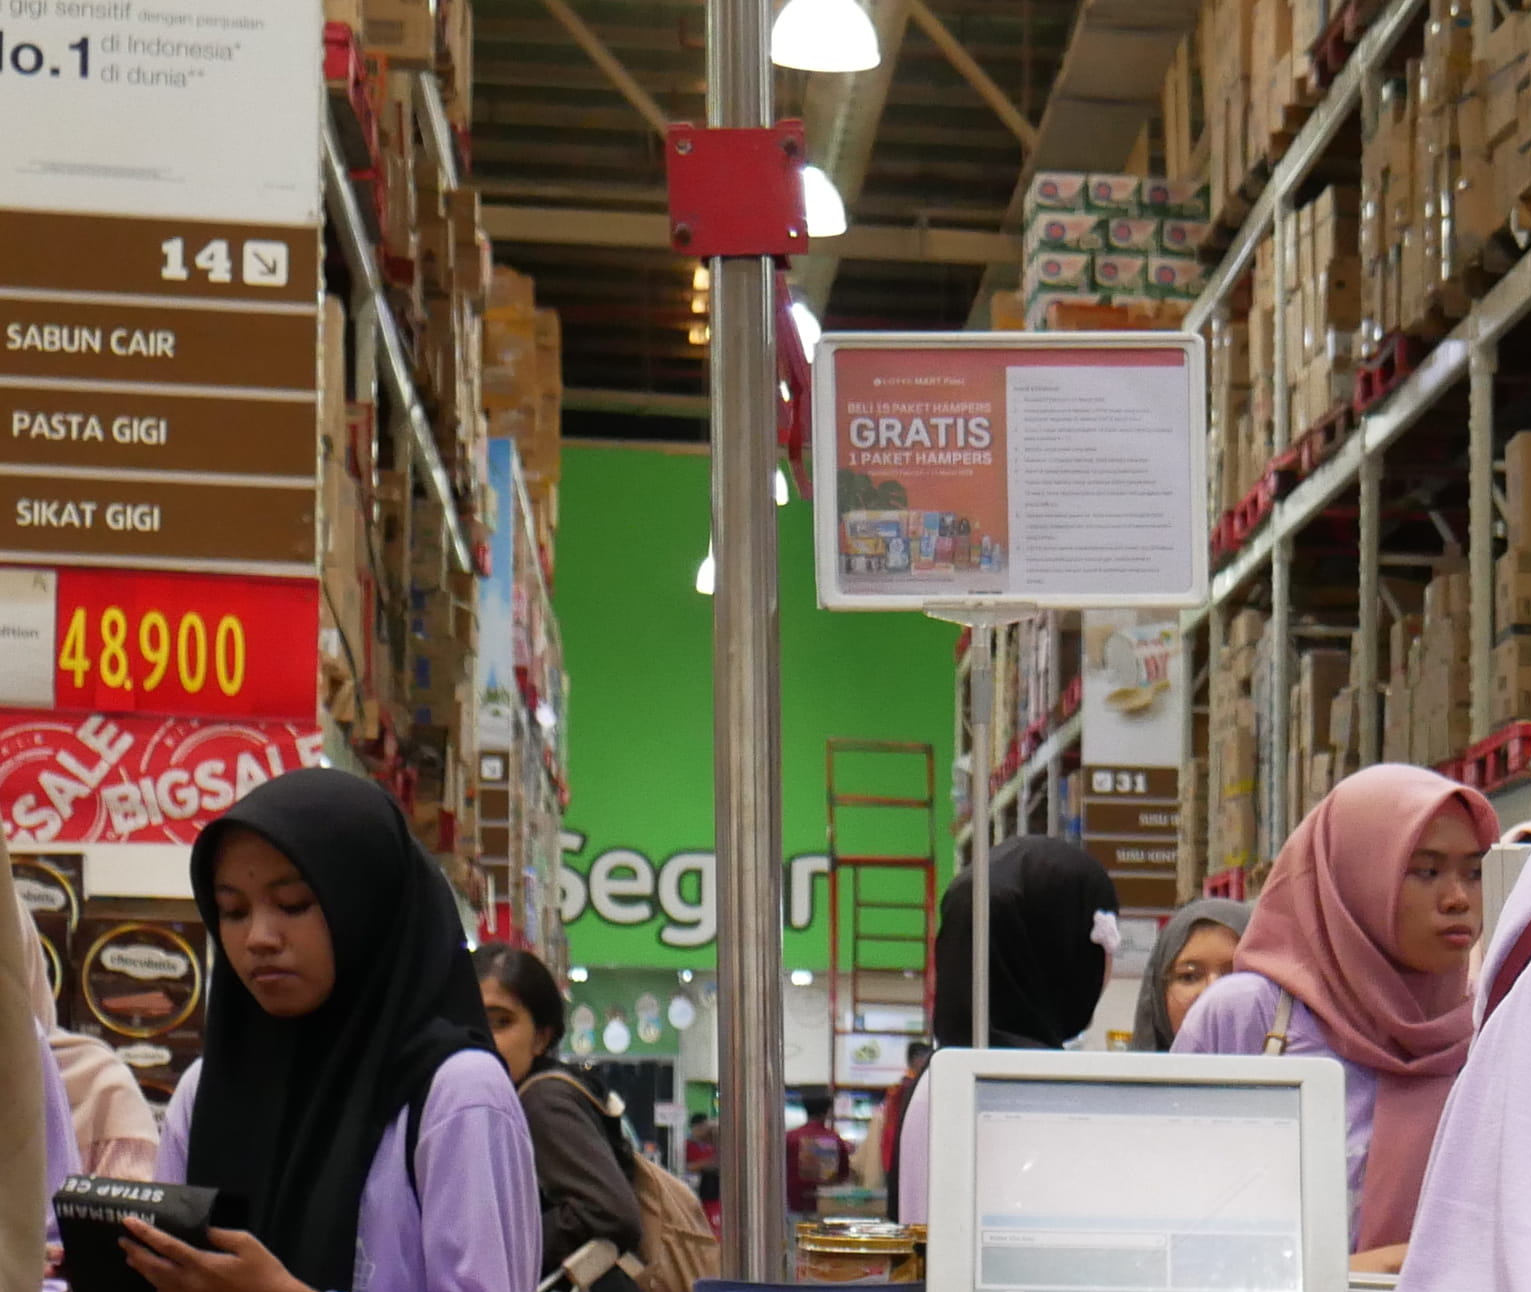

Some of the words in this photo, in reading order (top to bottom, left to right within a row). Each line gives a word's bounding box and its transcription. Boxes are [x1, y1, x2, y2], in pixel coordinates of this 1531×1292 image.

[0, 31, 90, 79] o.1
[101, 34, 120, 53] di
[101, 65, 120, 83] di
[161, 238, 232, 284] 14
[6, 322, 102, 354] SABUN
[110, 328, 176, 359] CAIR
[12, 413, 104, 443] PASTA
[112, 418, 167, 445] GIGI
[850, 416, 992, 449] GRATIS
[860, 451, 913, 466] PAKET
[915, 451, 993, 466] HAMPERS
[16, 499, 98, 529] SIKAT
[105, 502, 161, 532] GIGI
[59, 605, 245, 697] 48.900
[1115, 773, 1148, 794] 31
